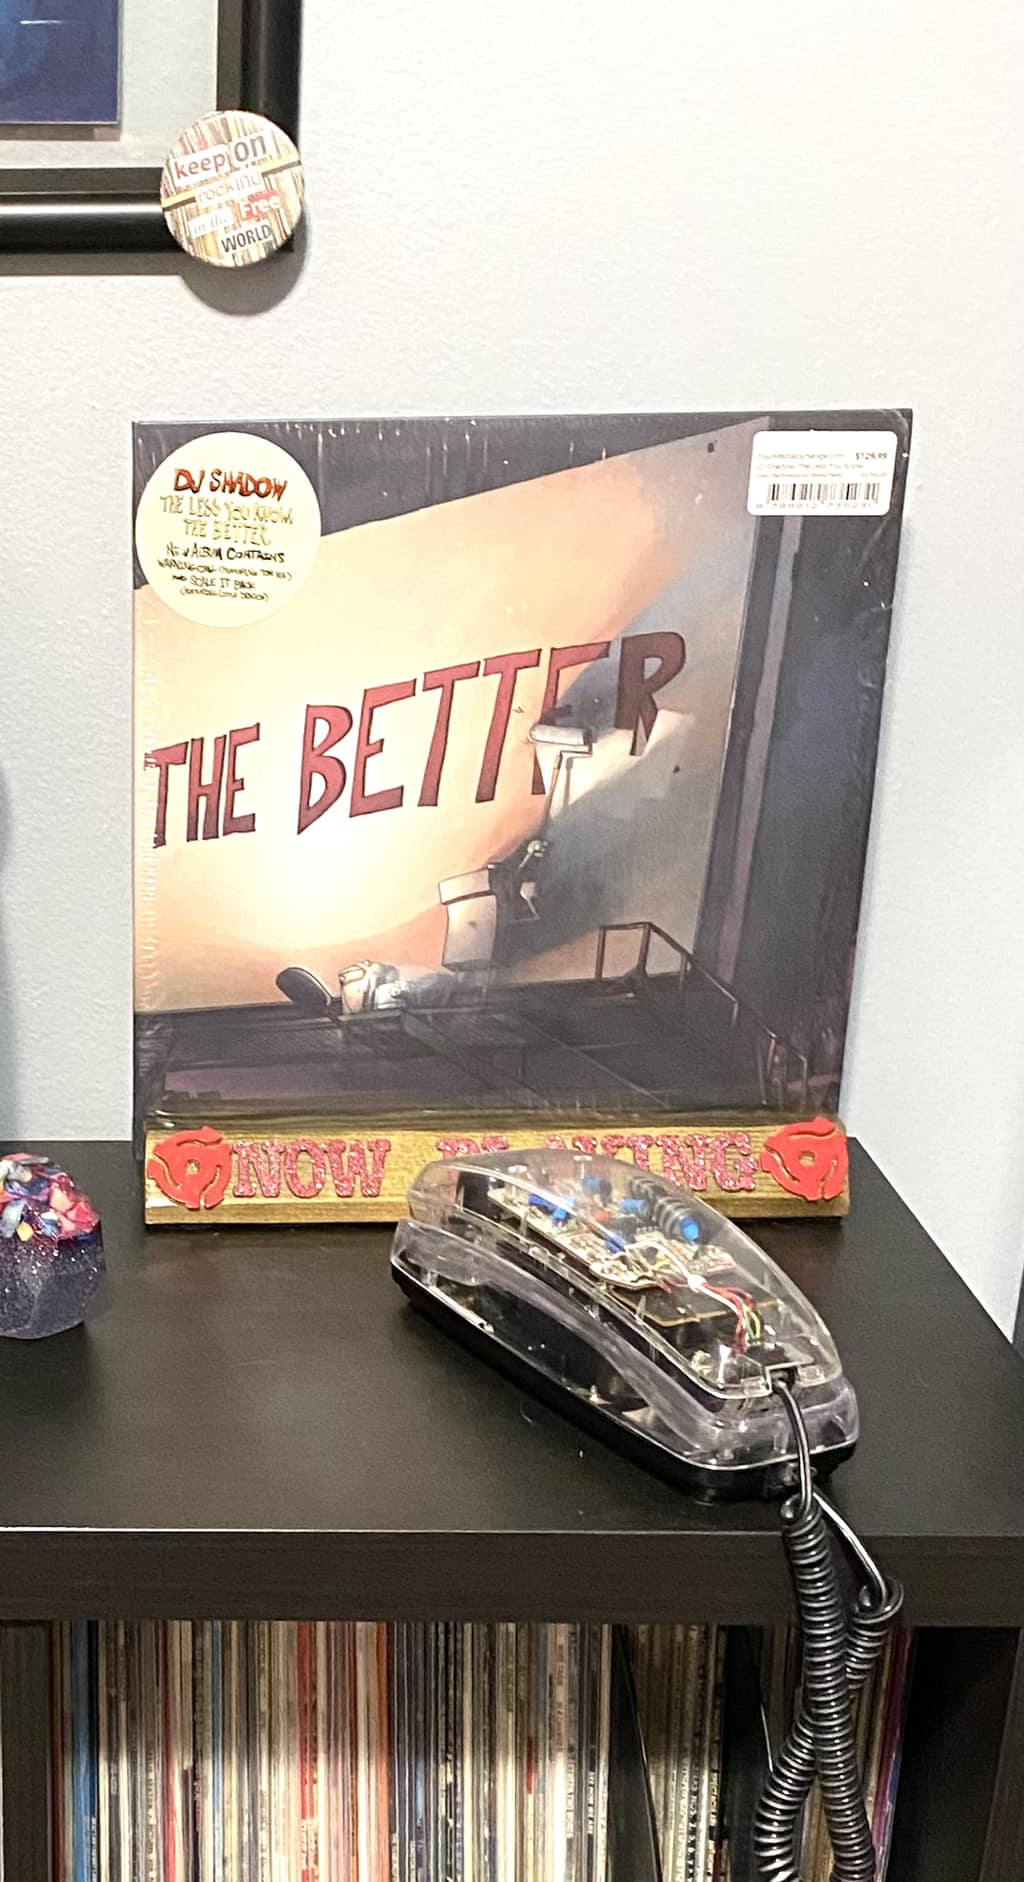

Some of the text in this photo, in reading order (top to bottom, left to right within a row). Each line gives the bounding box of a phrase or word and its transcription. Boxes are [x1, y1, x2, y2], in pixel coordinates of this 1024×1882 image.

[175, 134, 267, 180] keep on
[238, 196, 282, 221] Free
[220, 224, 273, 253] WORLD
[173, 468, 288, 502] DJ SHADOW
[144, 631, 687, 848] THE BETTER
[233, 1137, 394, 1199] NOW
